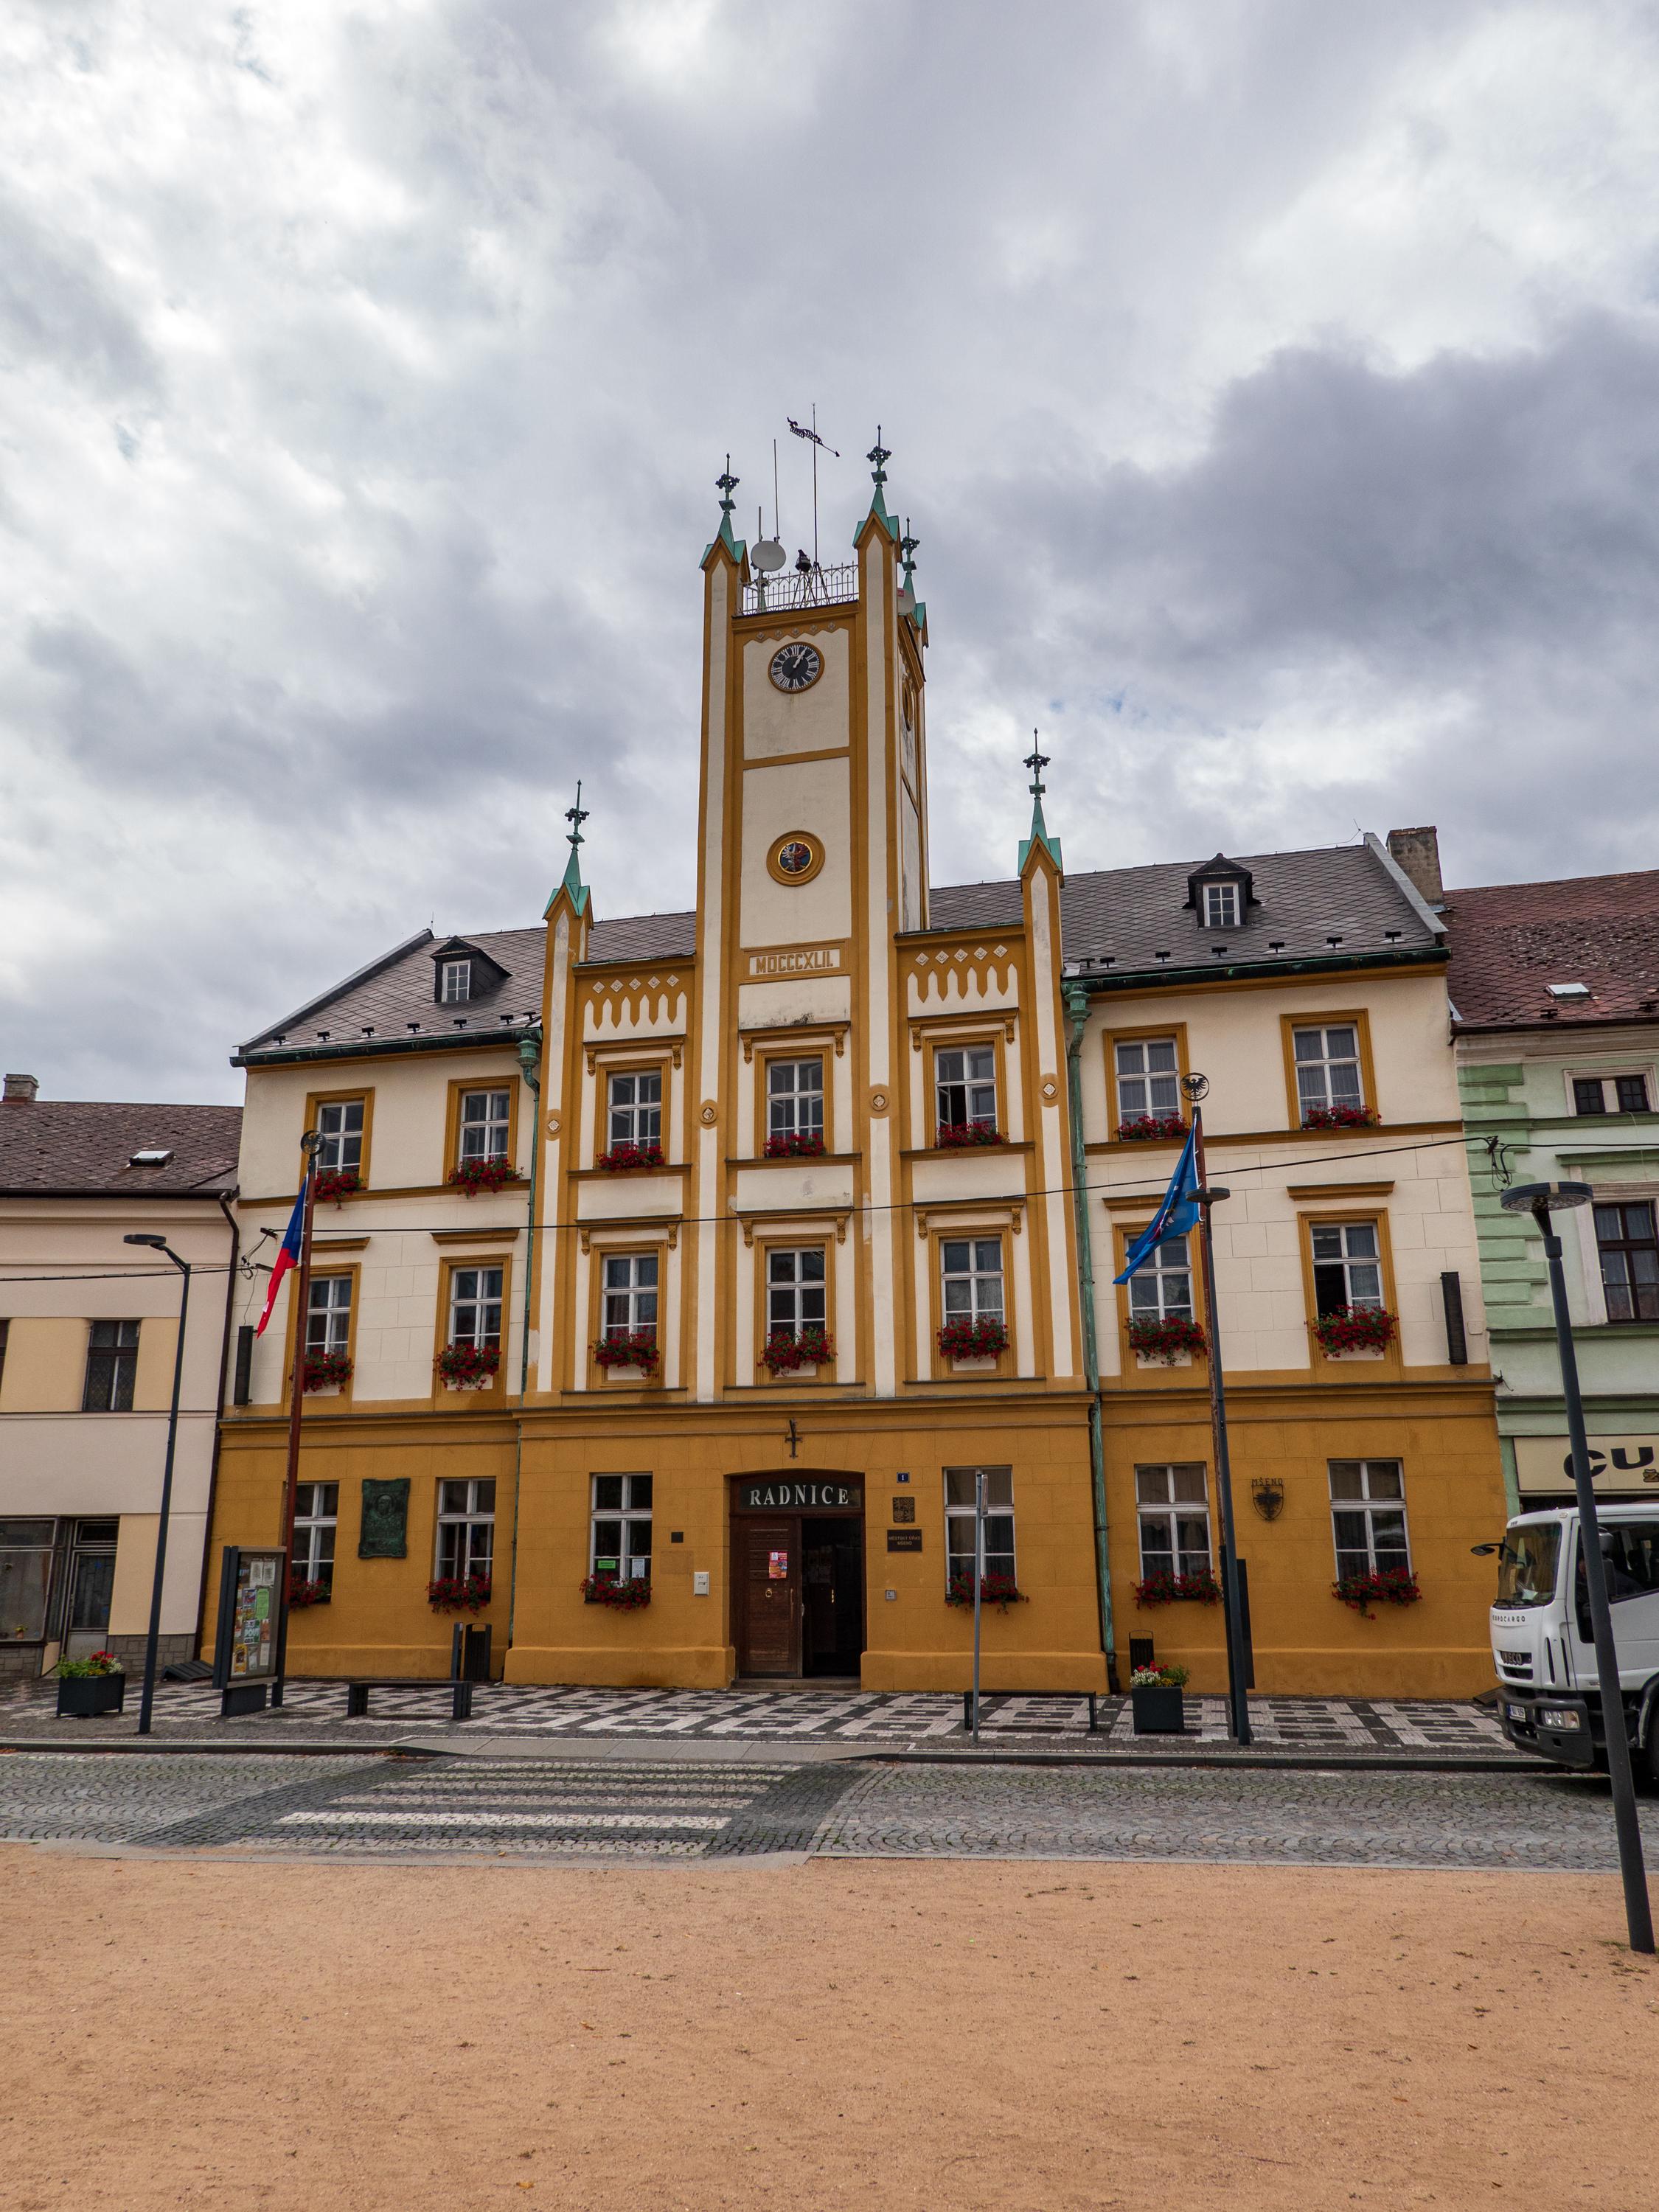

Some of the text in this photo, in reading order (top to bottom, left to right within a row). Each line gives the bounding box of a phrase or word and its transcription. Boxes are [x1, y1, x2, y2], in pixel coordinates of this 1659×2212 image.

[1251, 1476, 1283, 1486] MŠENO
[749, 1484, 849, 1505] RADNICE
[1501, 1651, 1523, 1666] IVECO
